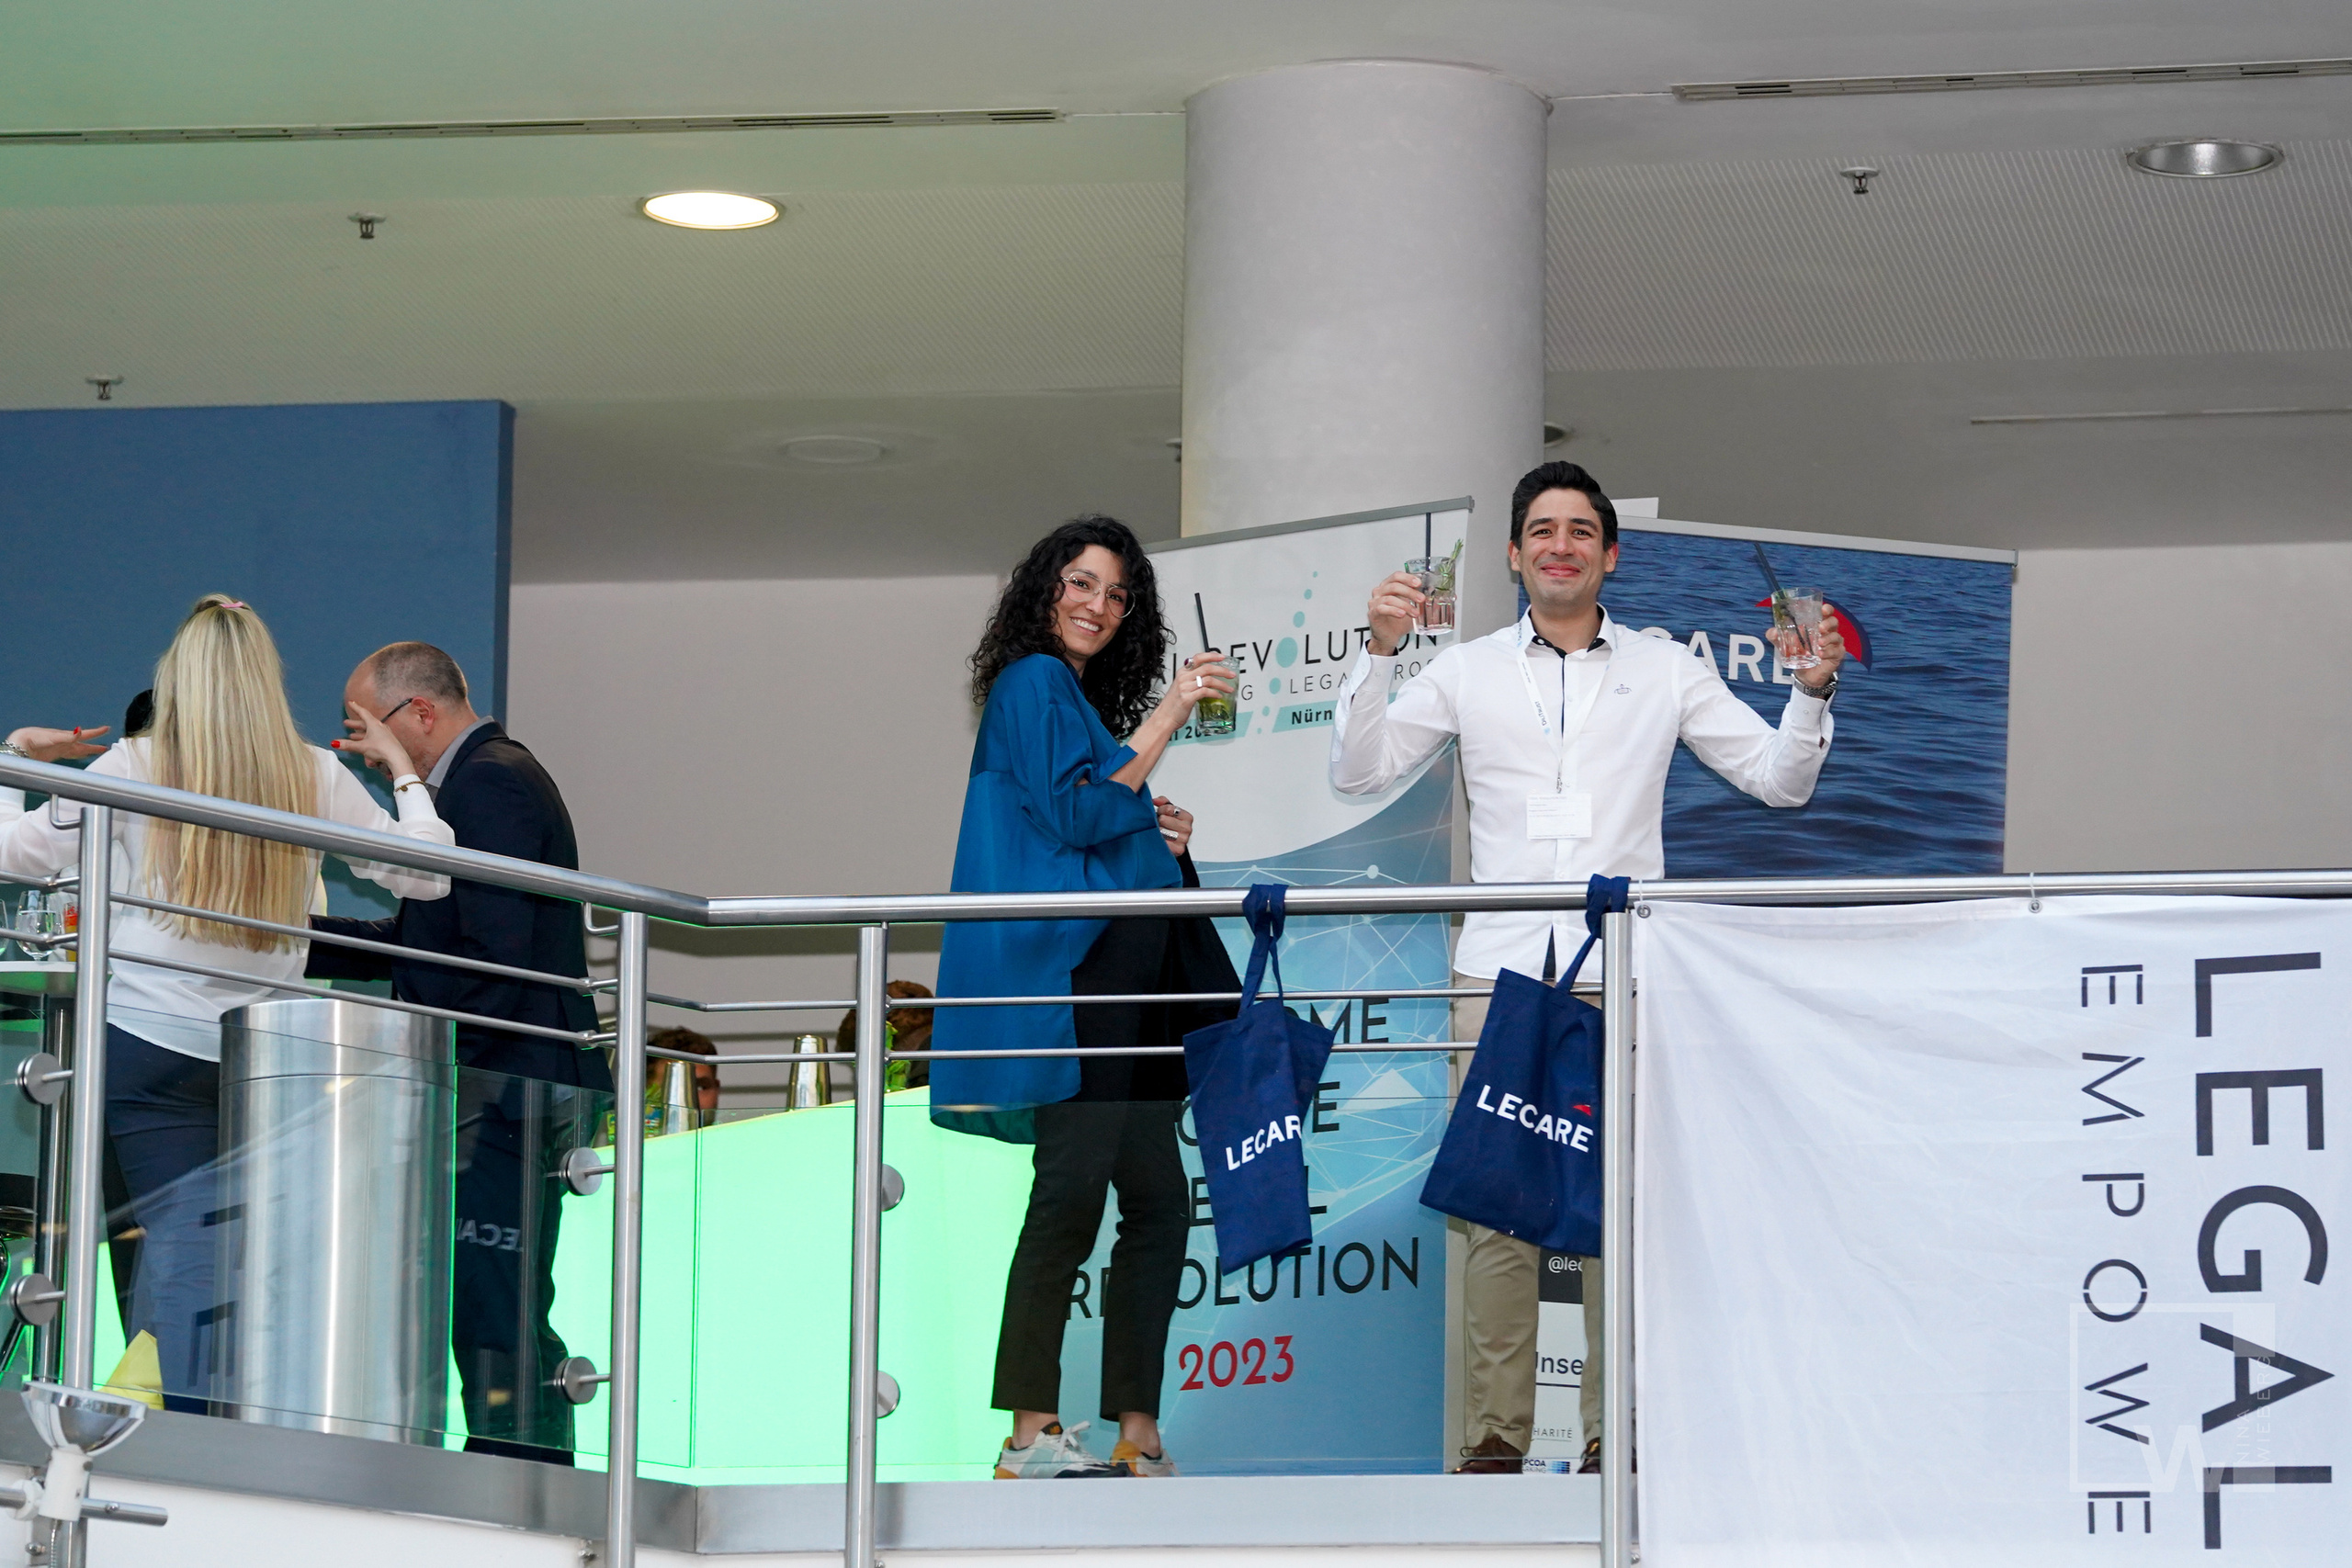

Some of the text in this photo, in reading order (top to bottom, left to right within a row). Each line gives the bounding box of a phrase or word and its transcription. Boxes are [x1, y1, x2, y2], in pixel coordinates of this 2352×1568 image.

[1205, 619, 1436, 678] EVOLUTN
[1290, 671, 1348, 694] LEGA
[1291, 708, 1332, 725] Nürn
[1226, 1114, 1302, 1171] LECAR
[1476, 1084, 1594, 1153] LECARE
[1066, 1236, 1419, 1321] ROLUTION
[2195, 952, 2335, 1550] LEGAL
[1179, 1335, 1295, 1392] 2023
[1535, 1351, 1583, 1375] nse
[1532, 1427, 1573, 1438] HARITÉ
